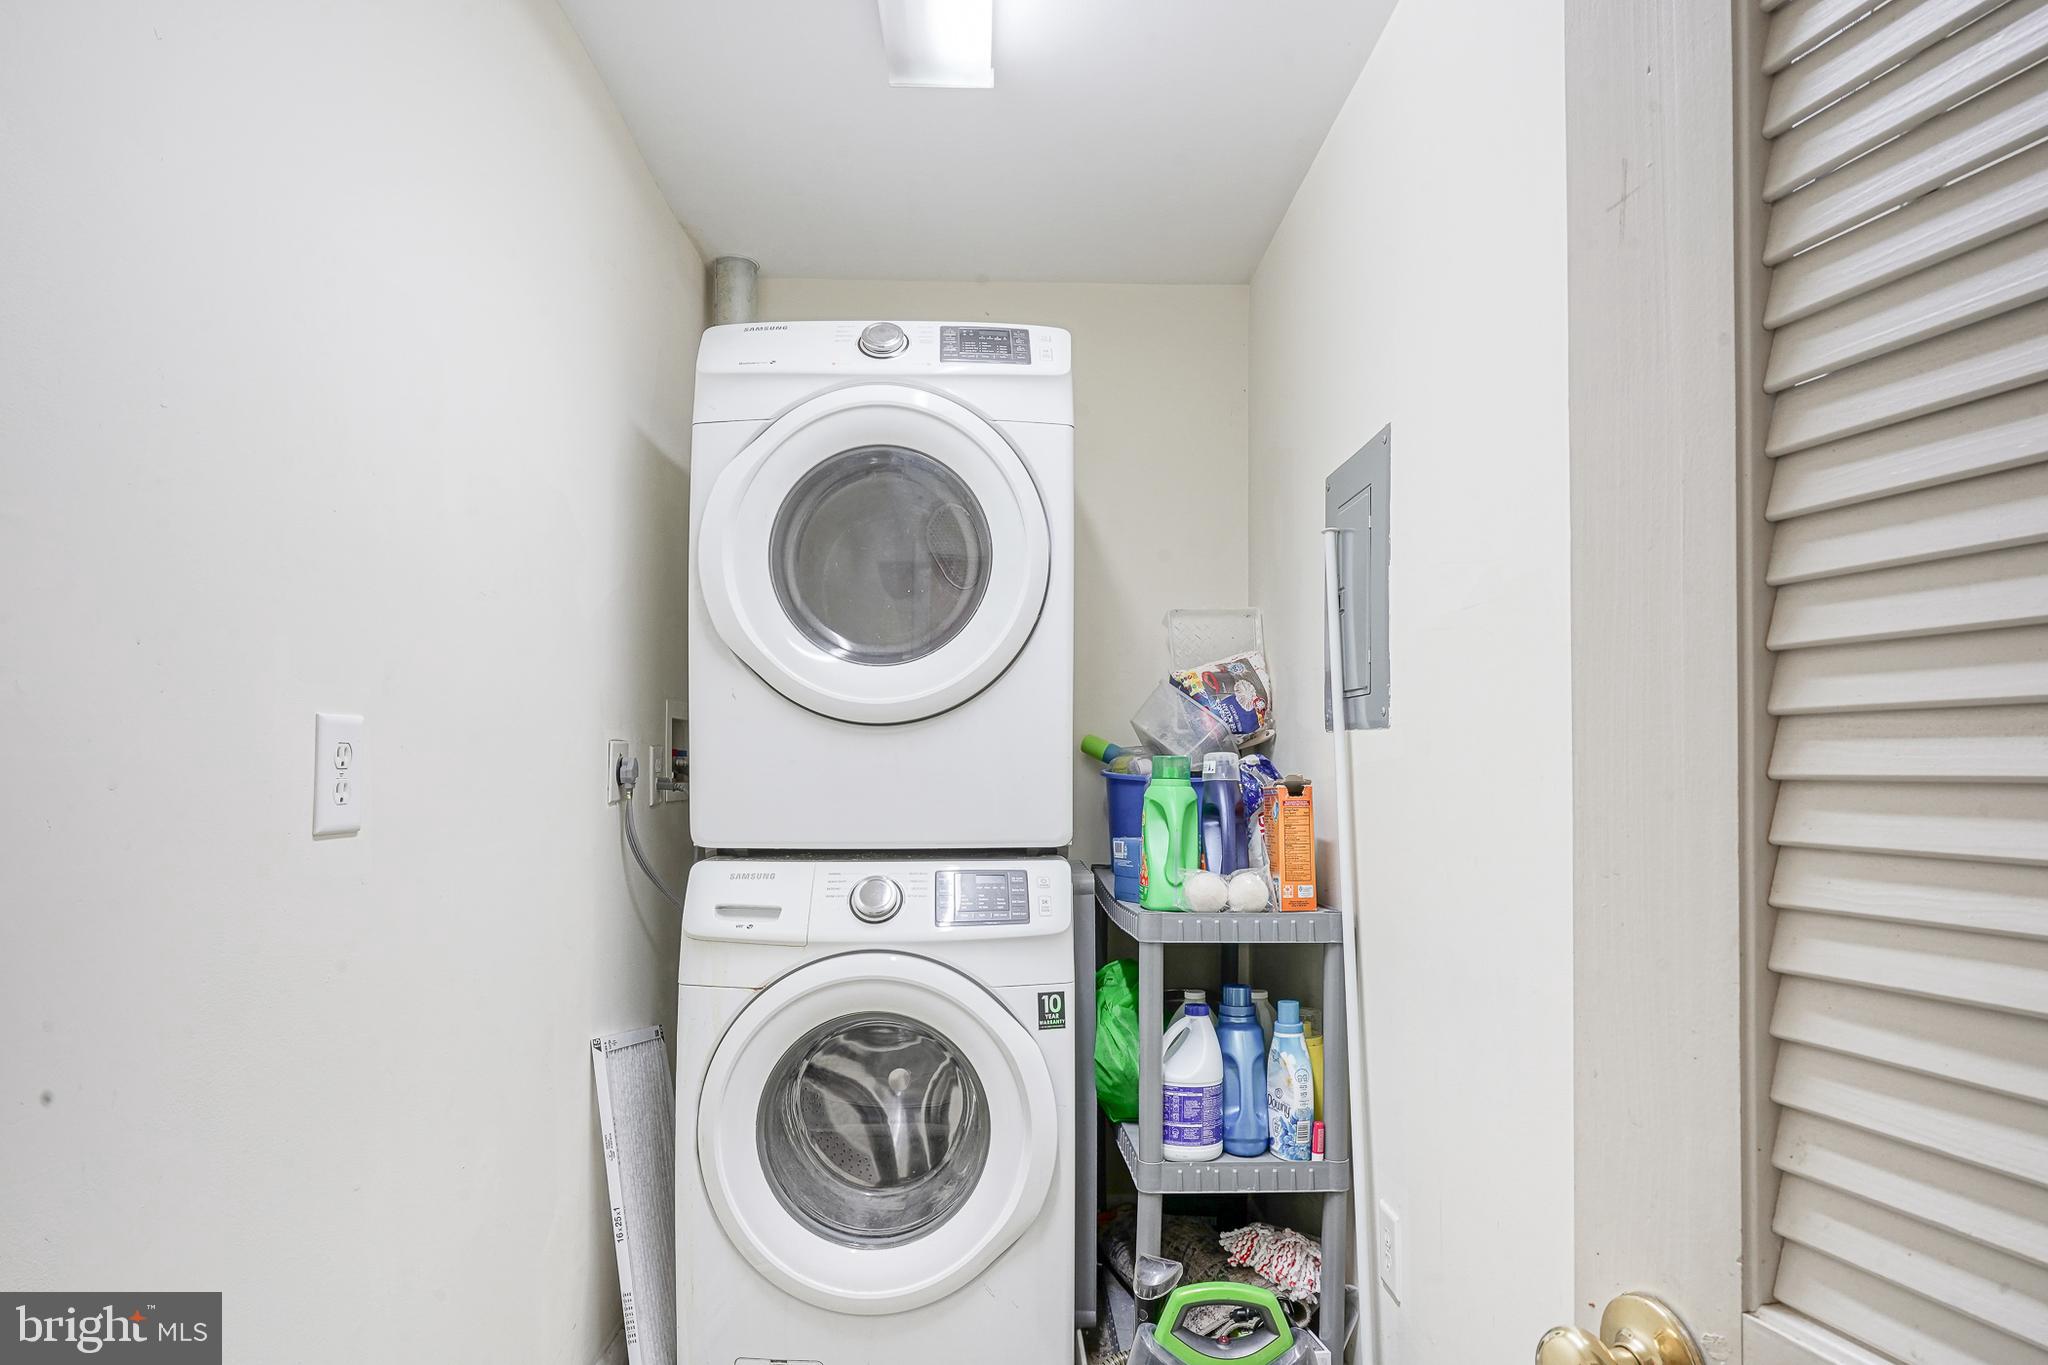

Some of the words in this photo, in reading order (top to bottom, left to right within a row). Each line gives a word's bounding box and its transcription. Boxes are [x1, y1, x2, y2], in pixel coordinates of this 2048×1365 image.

[729, 872, 776, 880] SAMSUNG
[1041, 994, 1062, 1013] 10
[1267, 1093, 1292, 1119] Downy
